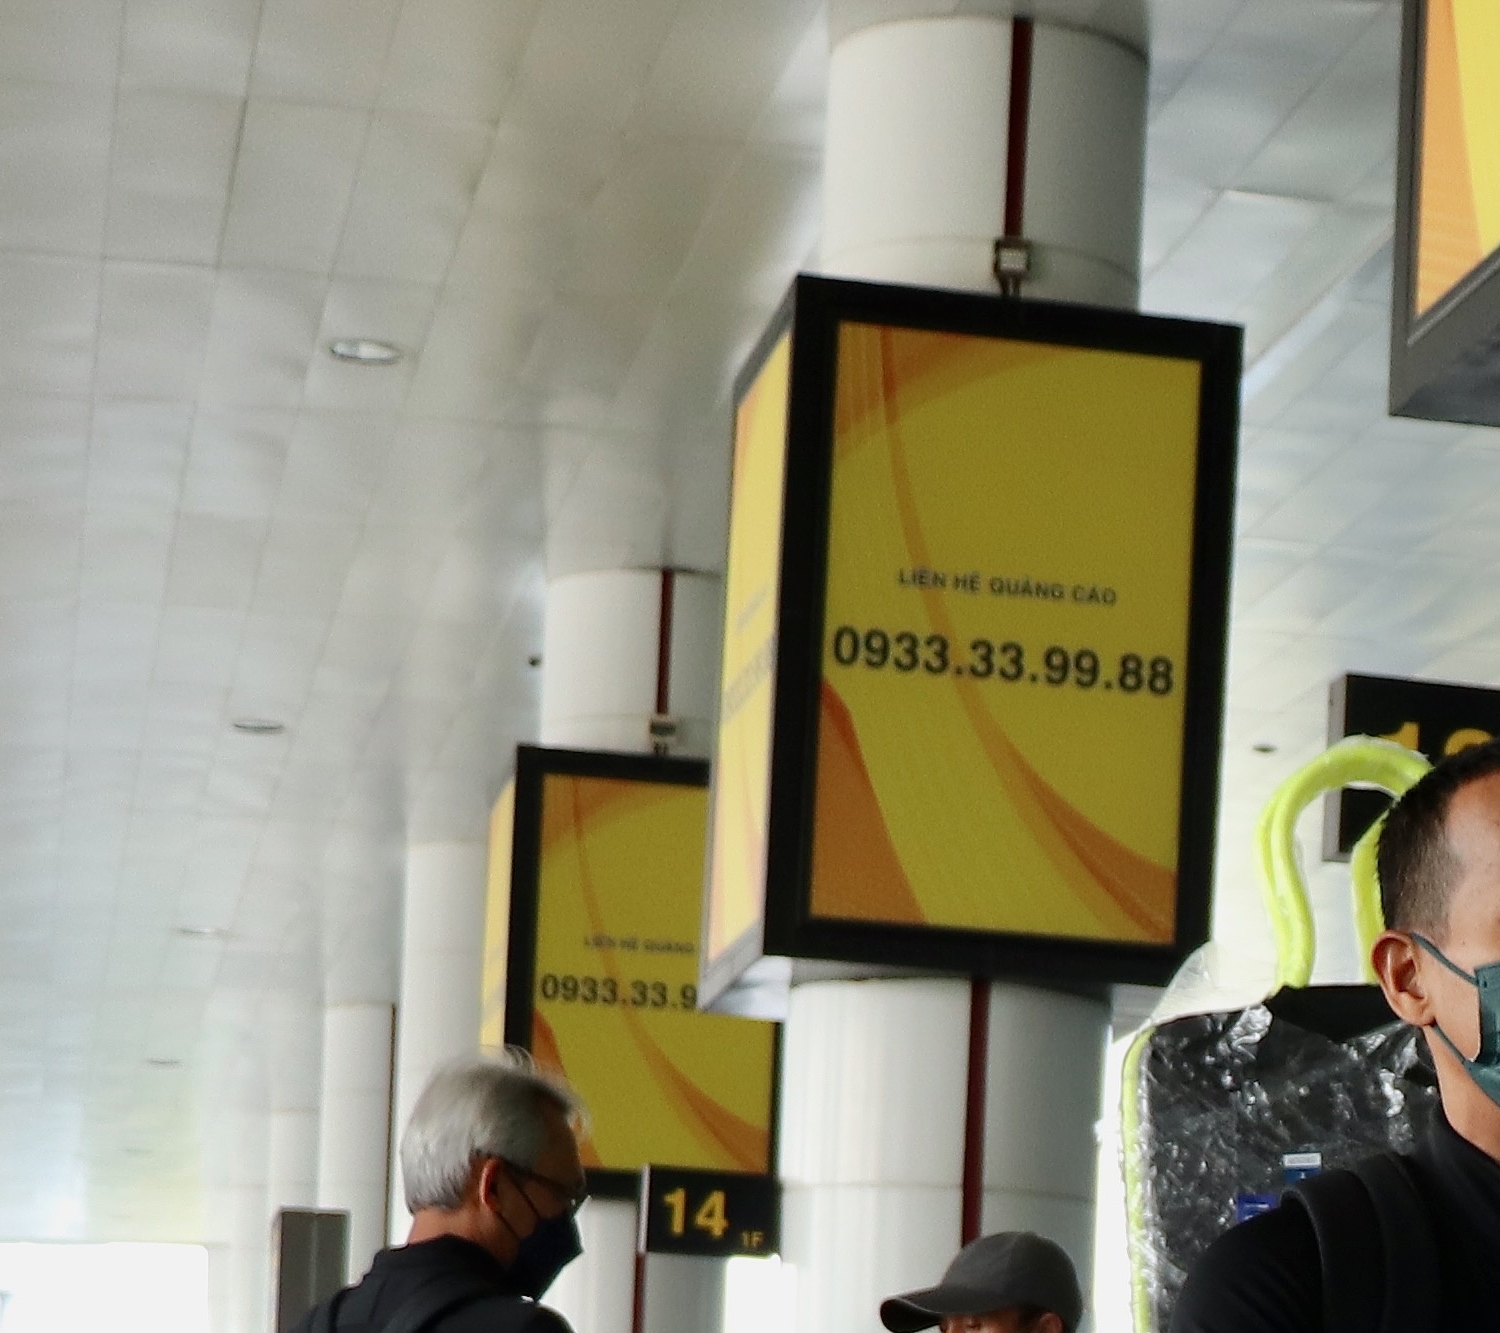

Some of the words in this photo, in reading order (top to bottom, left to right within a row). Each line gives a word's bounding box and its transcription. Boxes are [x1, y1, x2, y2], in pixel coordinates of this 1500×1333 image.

[833, 625, 1175, 696] 0933.33.99.88
[662, 1187, 729, 1240] 14
[740, 1229, 765, 1248] 1F
